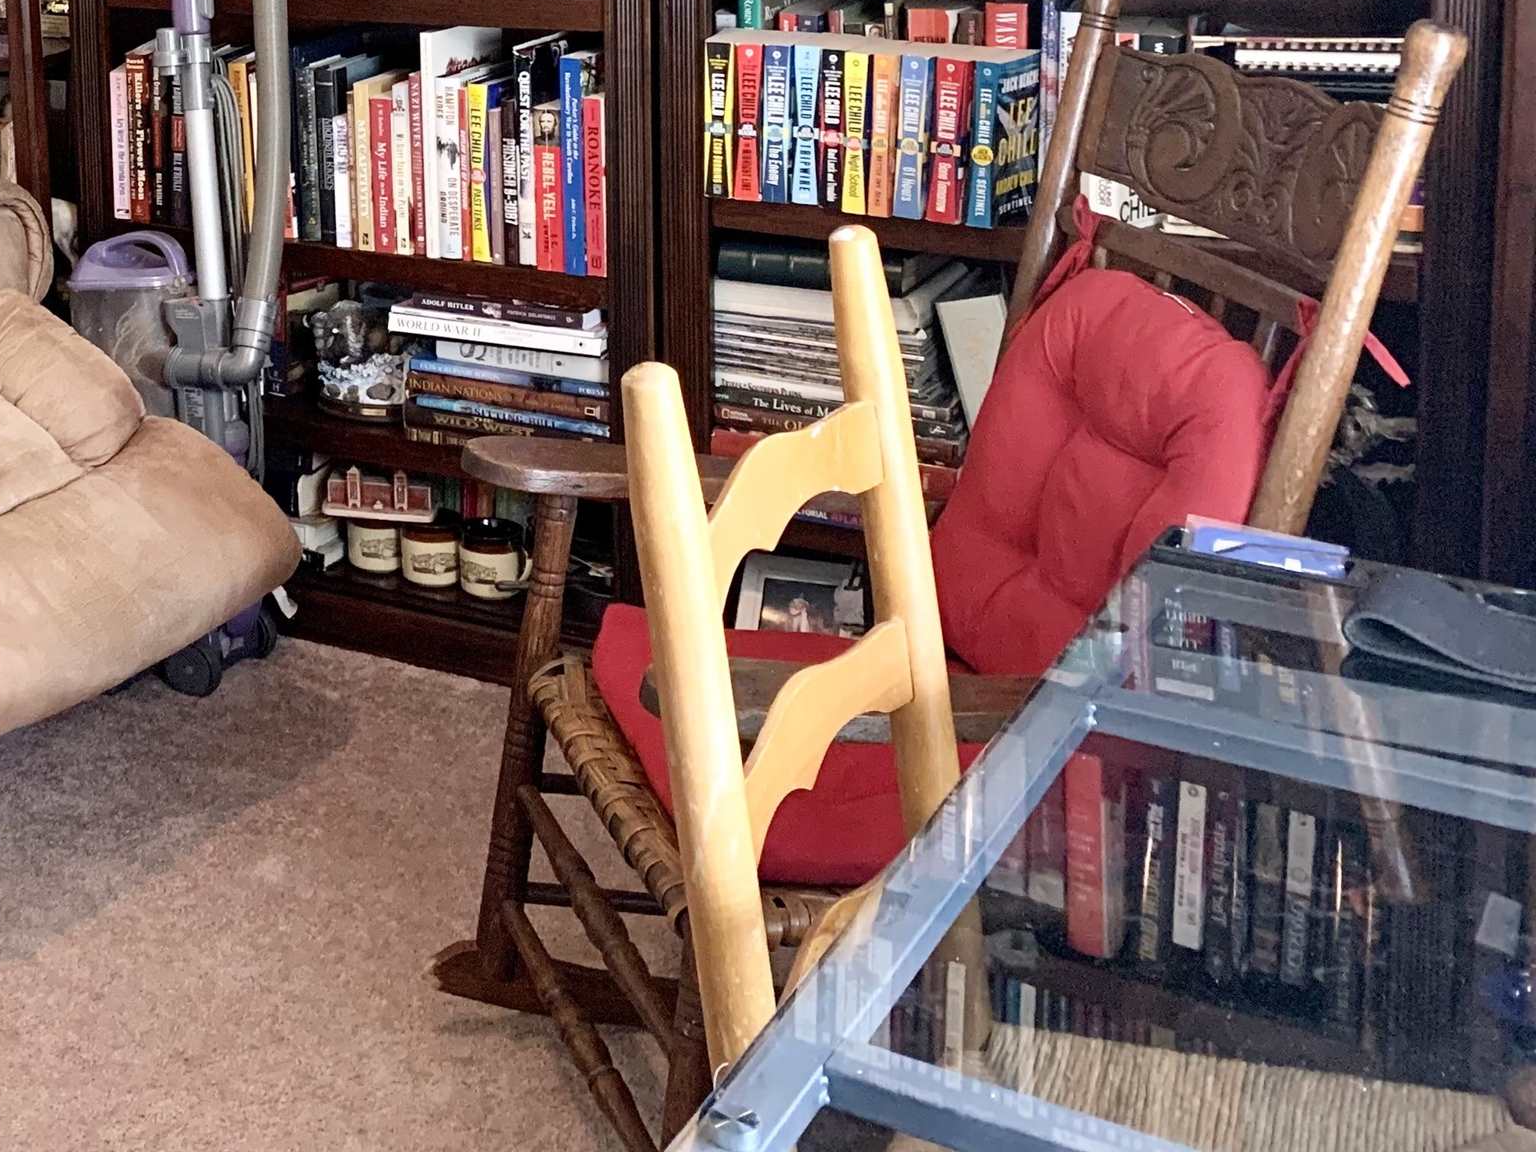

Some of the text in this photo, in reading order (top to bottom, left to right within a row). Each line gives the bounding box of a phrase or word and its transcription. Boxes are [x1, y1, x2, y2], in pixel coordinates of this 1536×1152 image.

[518, 71, 531, 108] QUEST
[712, 73, 725, 116] LEE CHILD
[742, 73, 757, 118] LEE CHILD
[801, 76, 813, 93] LEE
[849, 85, 862, 104] LEE
[905, 88, 920, 105] LEE
[801, 94, 813, 119] CHILD
[825, 81, 840, 124] LEE CHILD
[939, 90, 955, 109] LEE
[411, 110, 421, 148] WIVES
[471, 108, 482, 128] LEE
[767, 76, 784, 185] LEE CHILD The Enemy
[849, 105, 862, 133] CHILD
[904, 107, 919, 132] CHILD
[938, 110, 954, 139] CHILD
[134, 73, 145, 200] Killers Flower Moon
[471, 131, 483, 163] CHILD
[519, 131, 531, 155] THE
[975, 88, 993, 216] LEE CHILD SENTINEL
[520, 156, 531, 181] PAST
[587, 126, 600, 210] ROANOKE
[375, 142, 390, 227] My Life Indian
[542, 152, 557, 220] REBEL YELL
[421, 298, 474, 311] ADOLF HITLER
[444, 323, 469, 336] WAR
[409, 378, 450, 393] INDIAN
[754, 398, 770, 408] The
[773, 399, 802, 414] Lives
